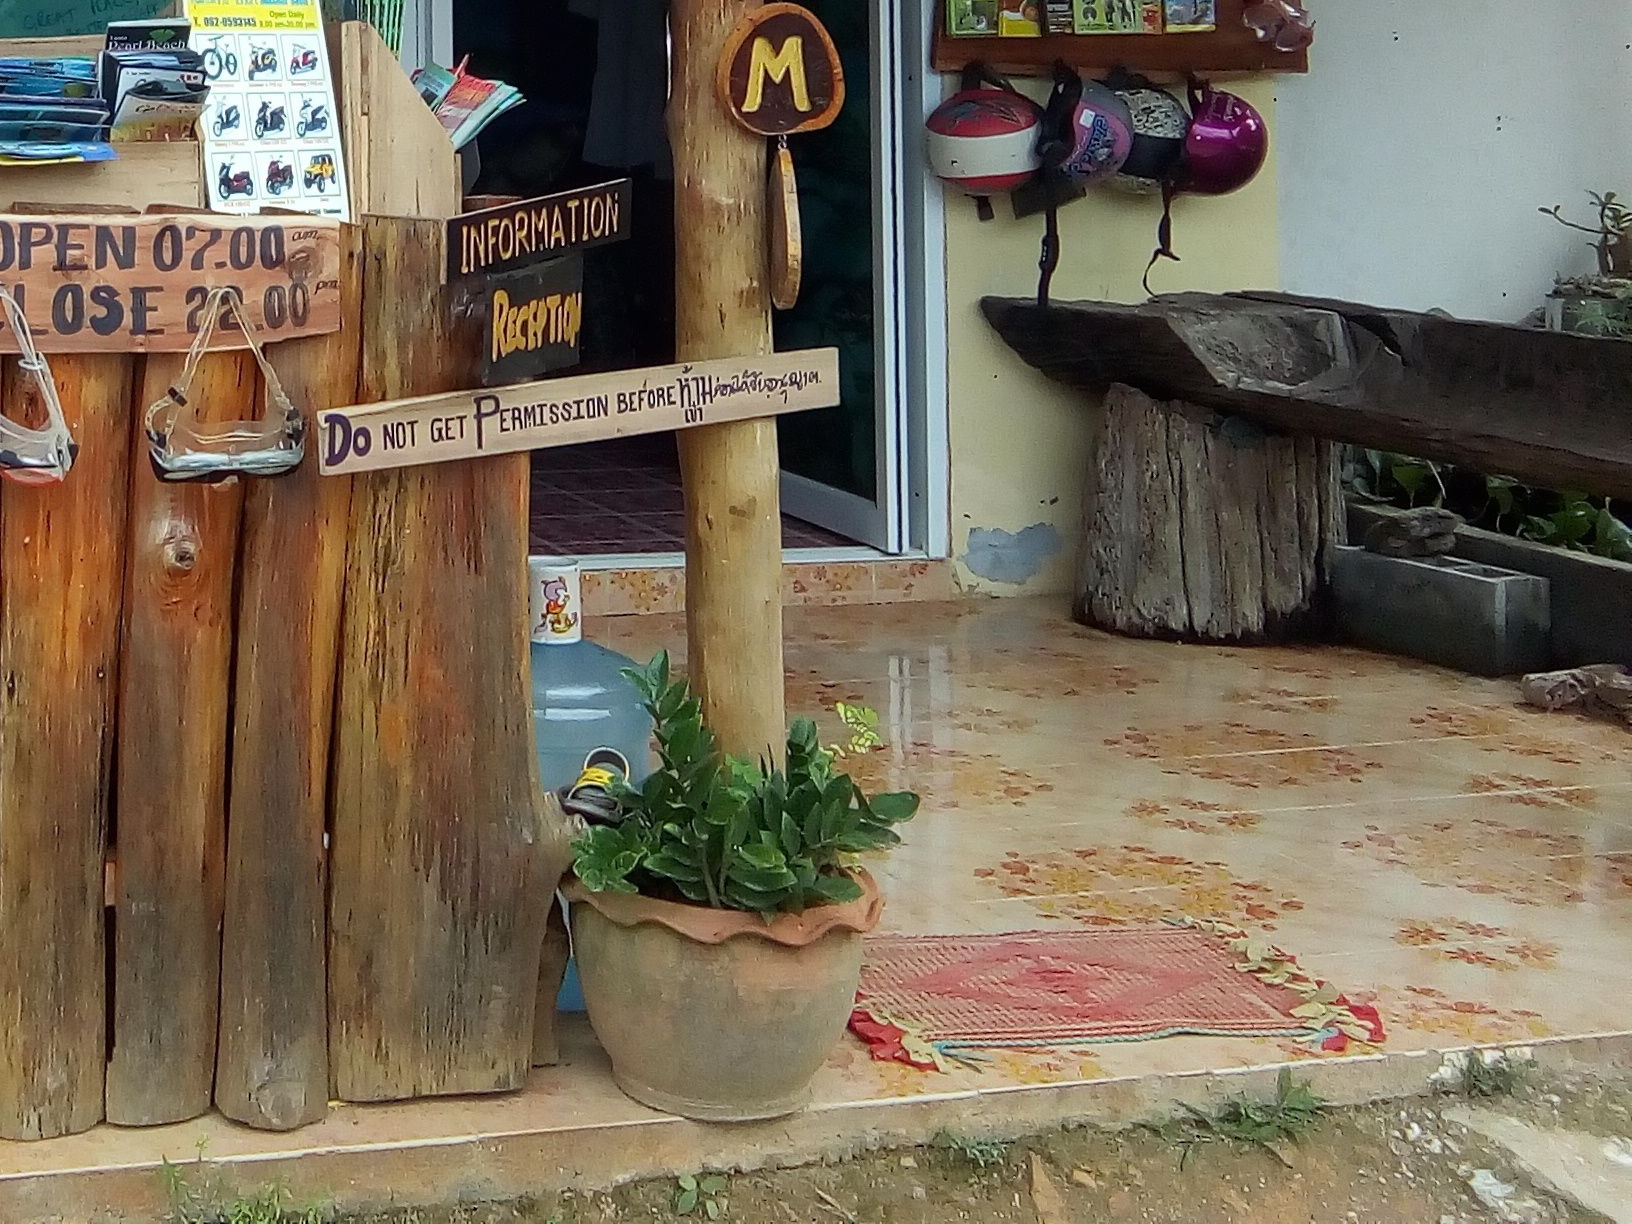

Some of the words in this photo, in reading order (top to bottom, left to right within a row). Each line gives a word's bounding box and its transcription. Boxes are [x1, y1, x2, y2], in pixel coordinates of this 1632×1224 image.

[741, 35, 812, 113] M
[153, 223, 286, 272] 07.00
[461, 190, 621, 274] INFORMATION
[185, 282, 311, 333] 22.00
[382, 419, 419, 452] NOT
[430, 414, 468, 444] GET
[472, 393, 609, 450] PERMISSION
[616, 384, 677, 415] BEFORE
